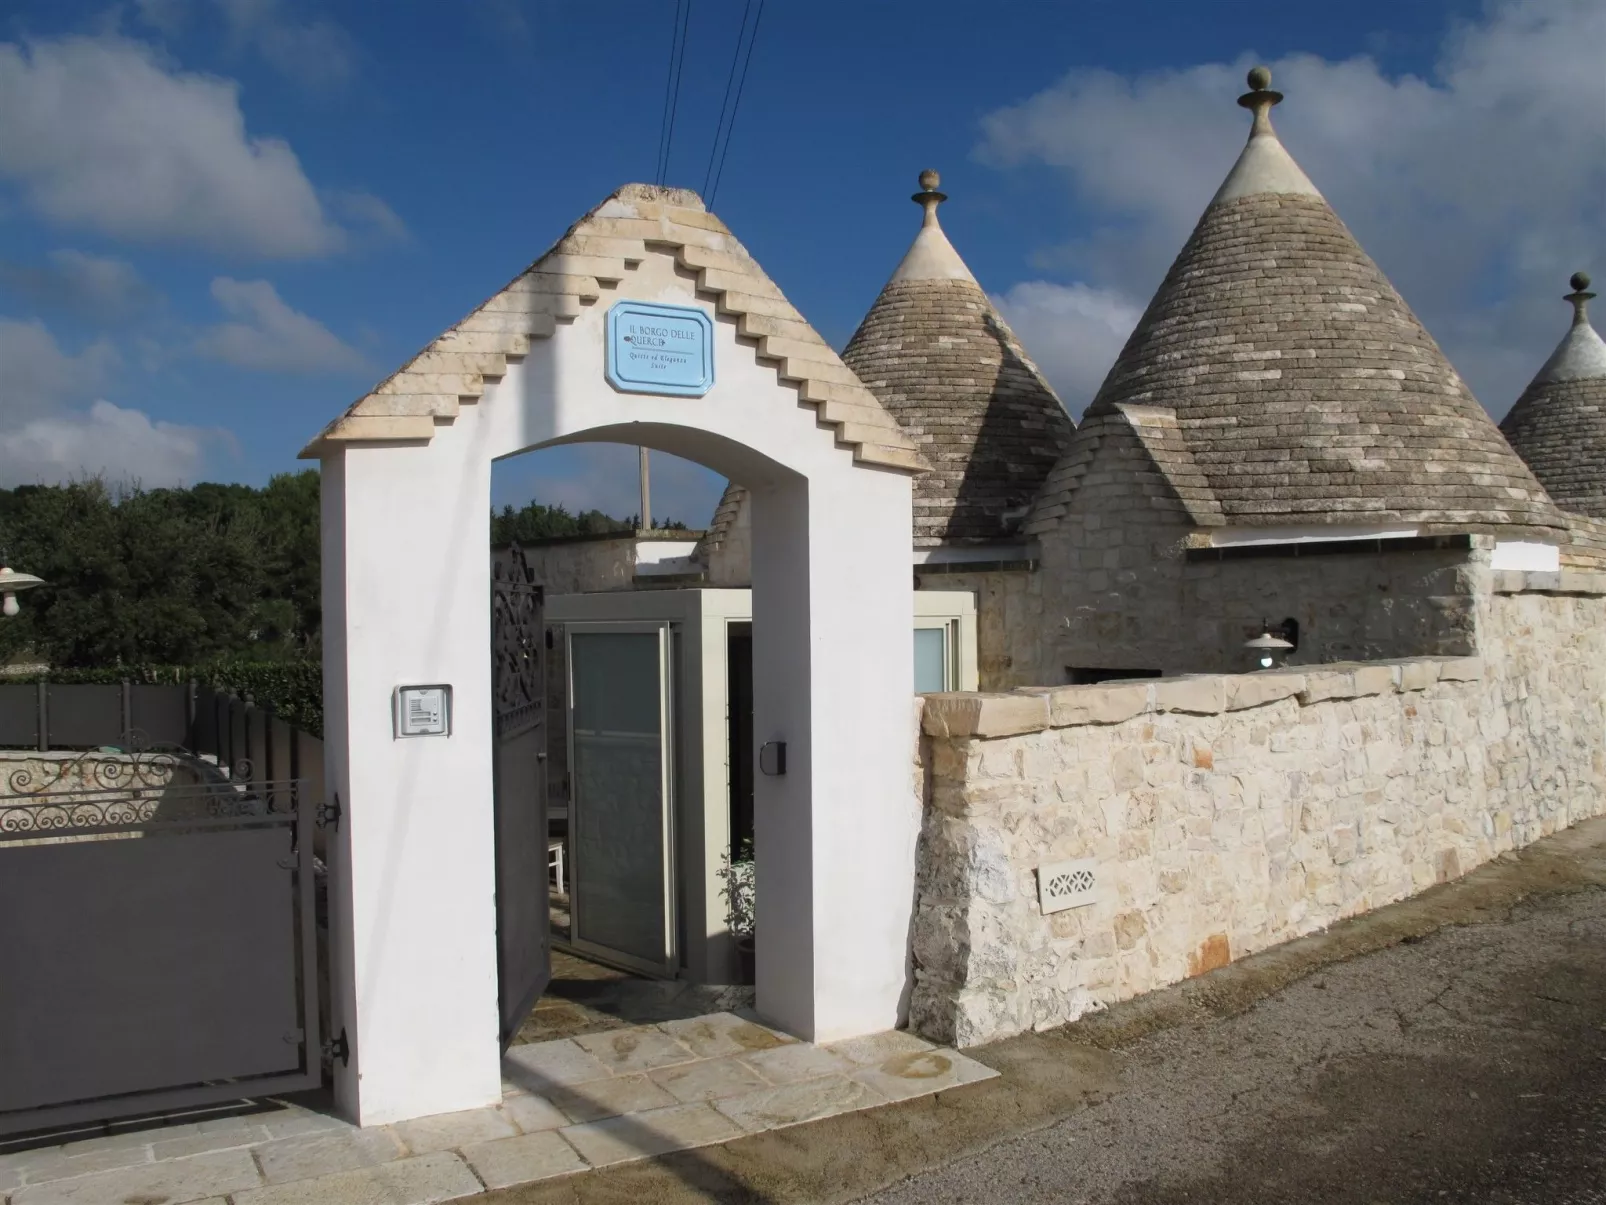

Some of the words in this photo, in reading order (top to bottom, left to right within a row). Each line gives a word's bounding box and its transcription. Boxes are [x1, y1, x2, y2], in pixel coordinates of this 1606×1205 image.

[629, 325, 636, 334] IL
[639, 326, 669, 337] BORGO
[671, 329, 695, 340] DELLE
